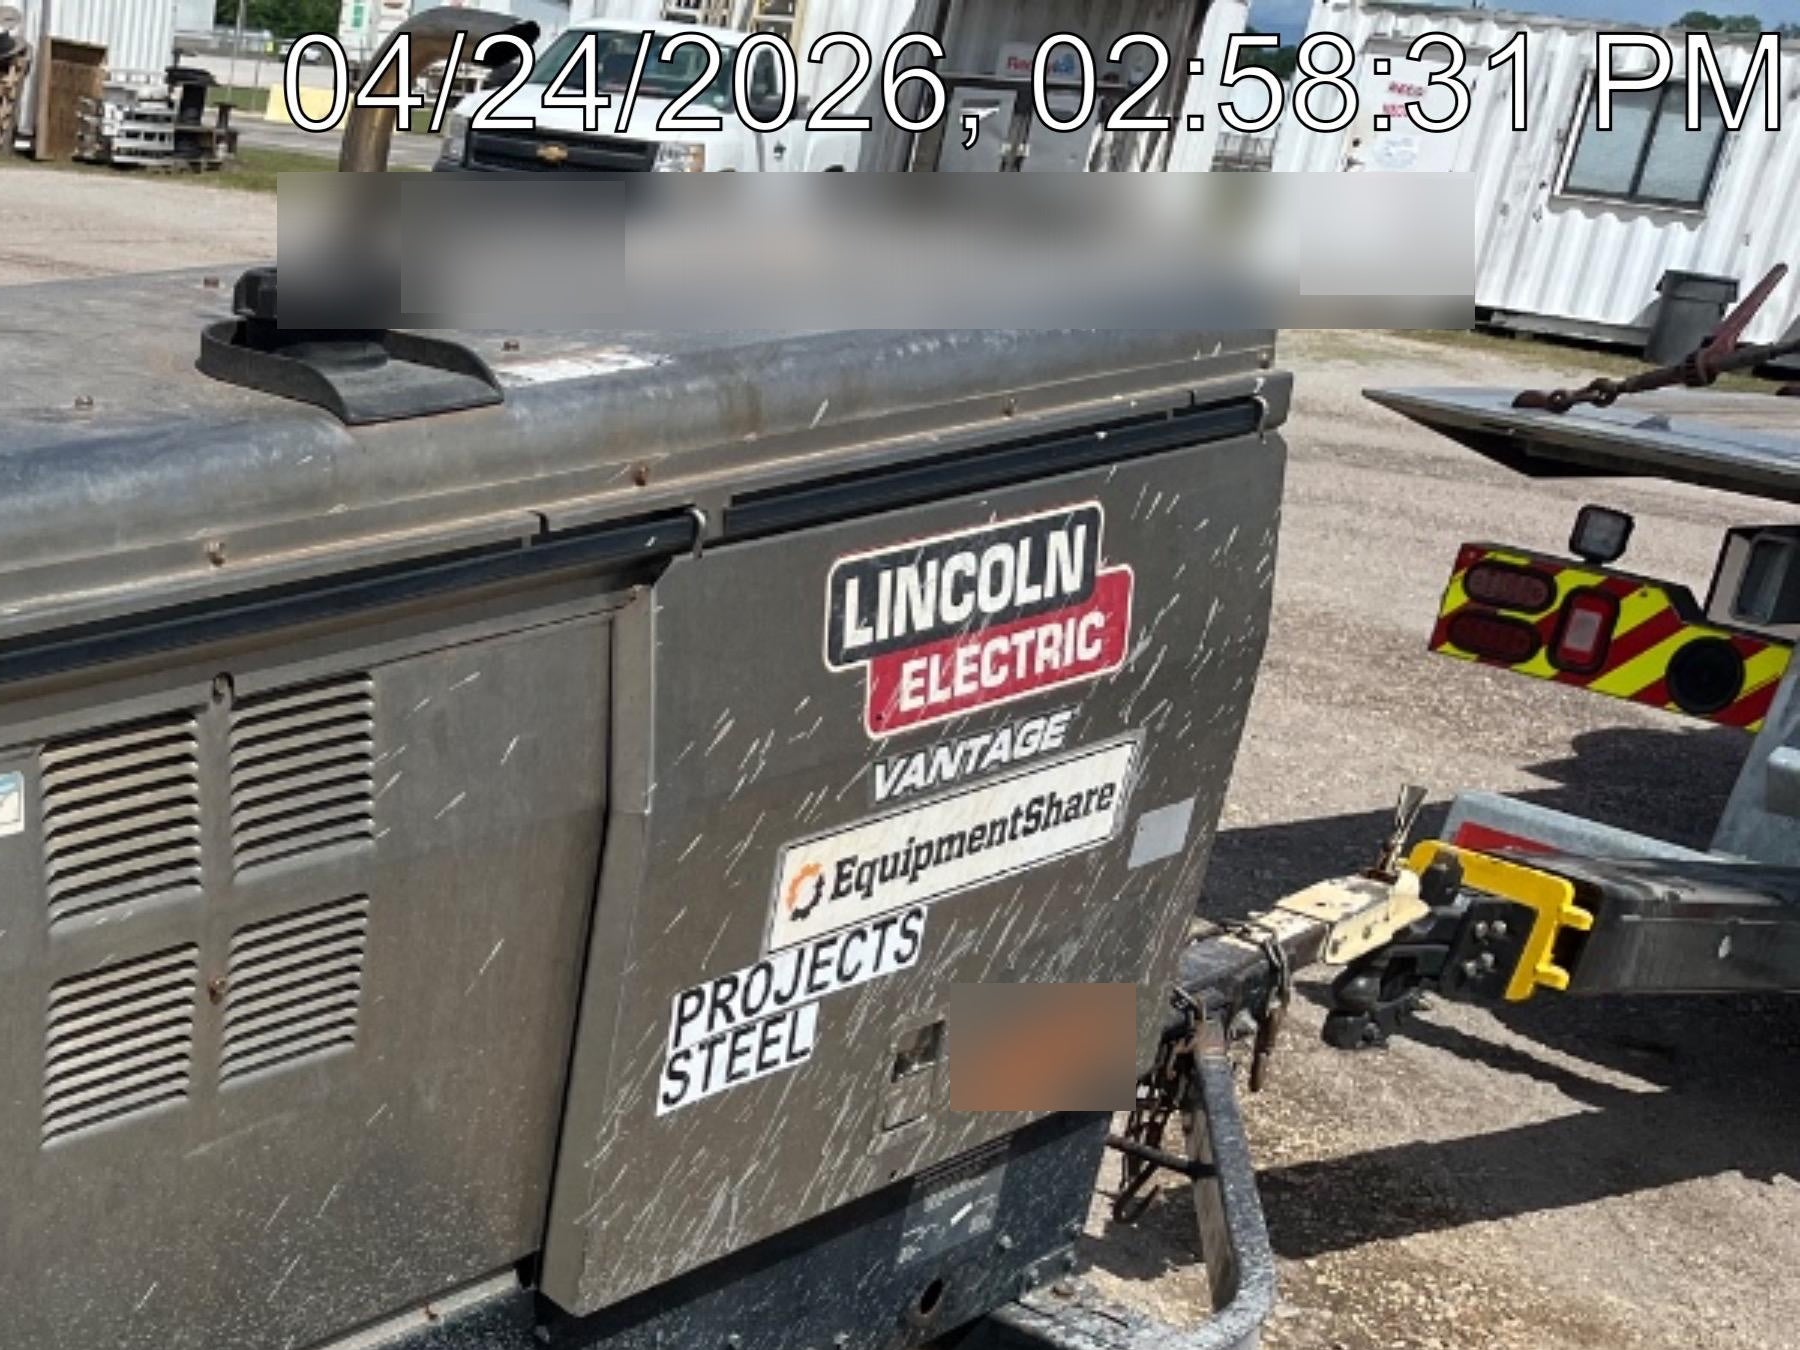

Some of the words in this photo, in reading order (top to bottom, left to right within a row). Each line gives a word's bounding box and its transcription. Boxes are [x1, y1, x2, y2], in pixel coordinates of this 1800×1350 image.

[842, 522, 1088, 652] LINCOLN
[899, 608, 1107, 713] ELECTRIC
[871, 709, 1072, 803] VANTAGE
[828, 777, 1117, 902] EquipmentShare
[673, 908, 924, 1050] PROJECTS
[661, 1010, 813, 1107] STEEL
